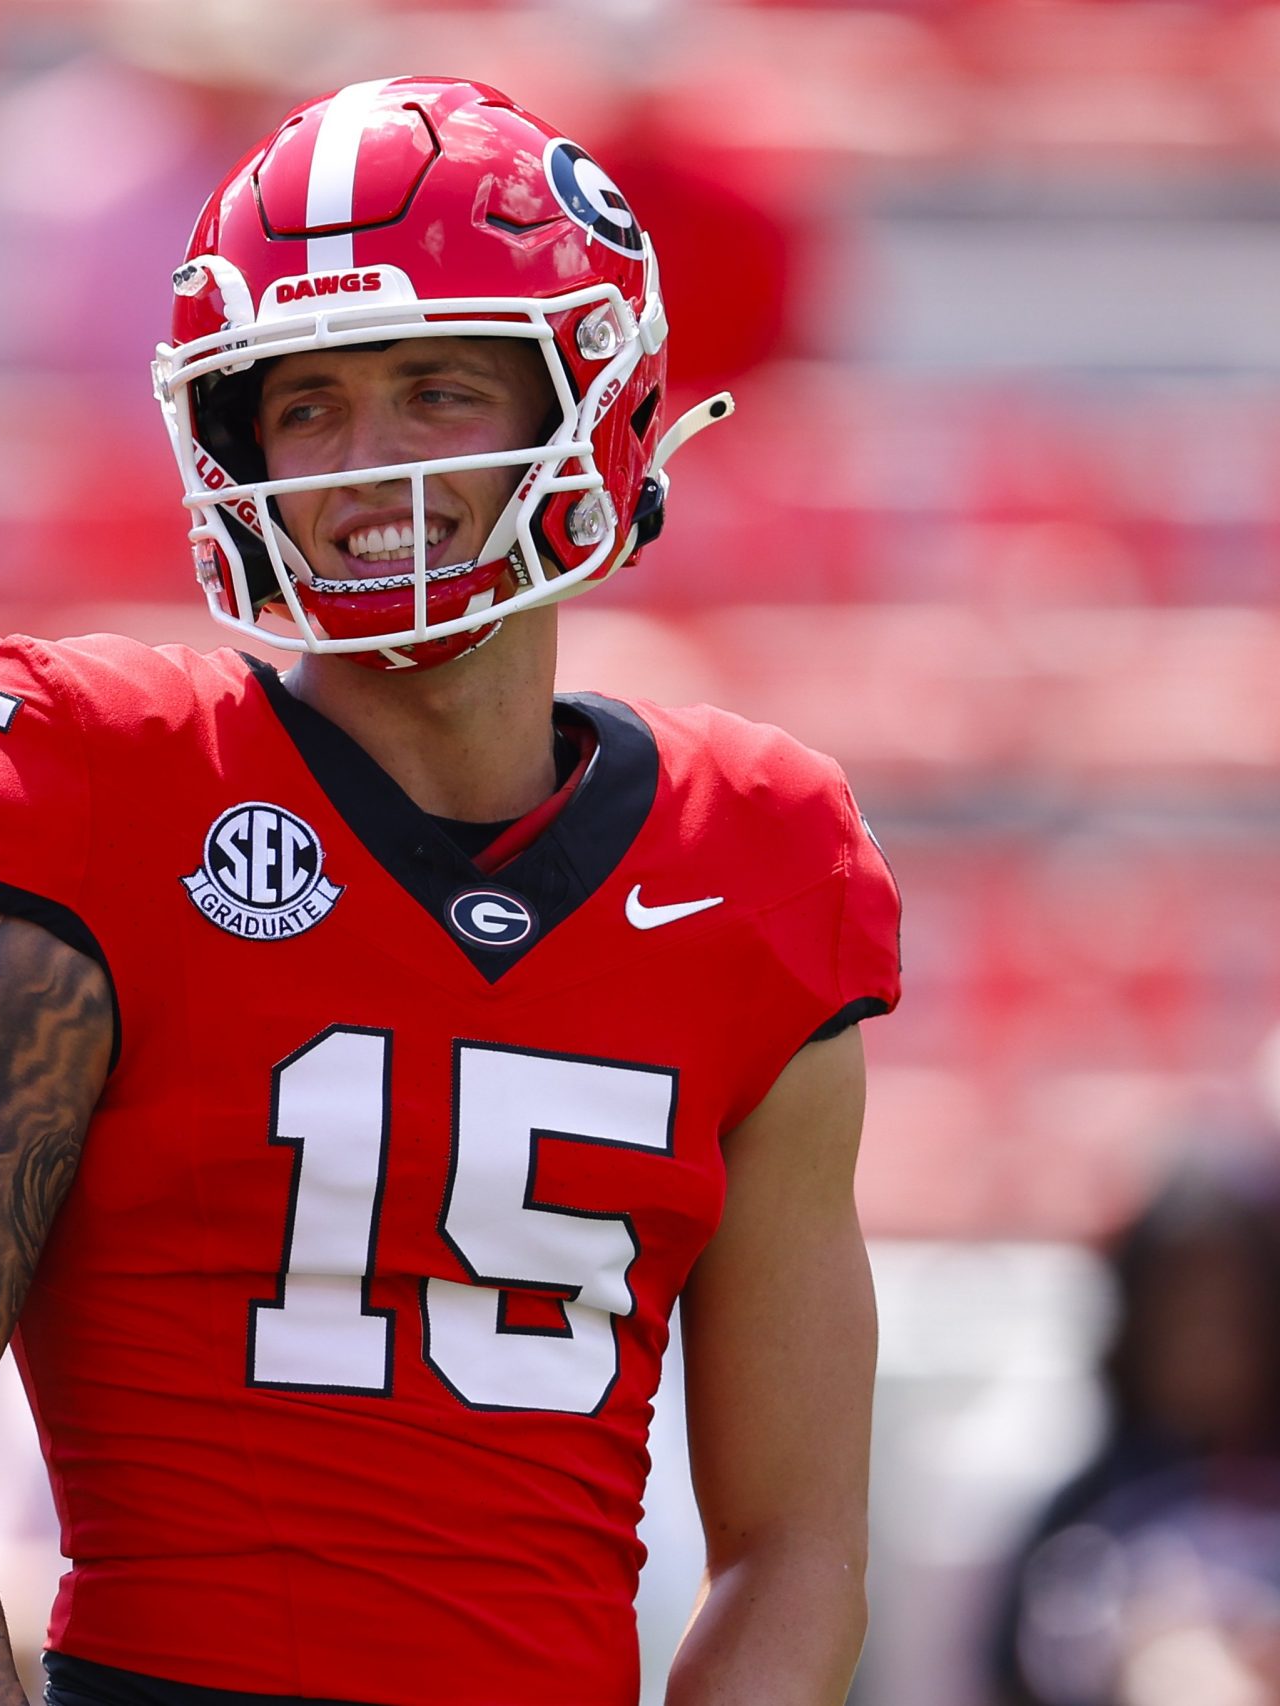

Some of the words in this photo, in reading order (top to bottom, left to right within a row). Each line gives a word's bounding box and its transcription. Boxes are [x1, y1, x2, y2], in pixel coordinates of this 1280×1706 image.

[276, 273, 381, 304] DAWGS
[216, 810, 310, 903] SEC
[201, 893, 322, 937] GRADUATE
[244, 1022, 680, 1417] 15
